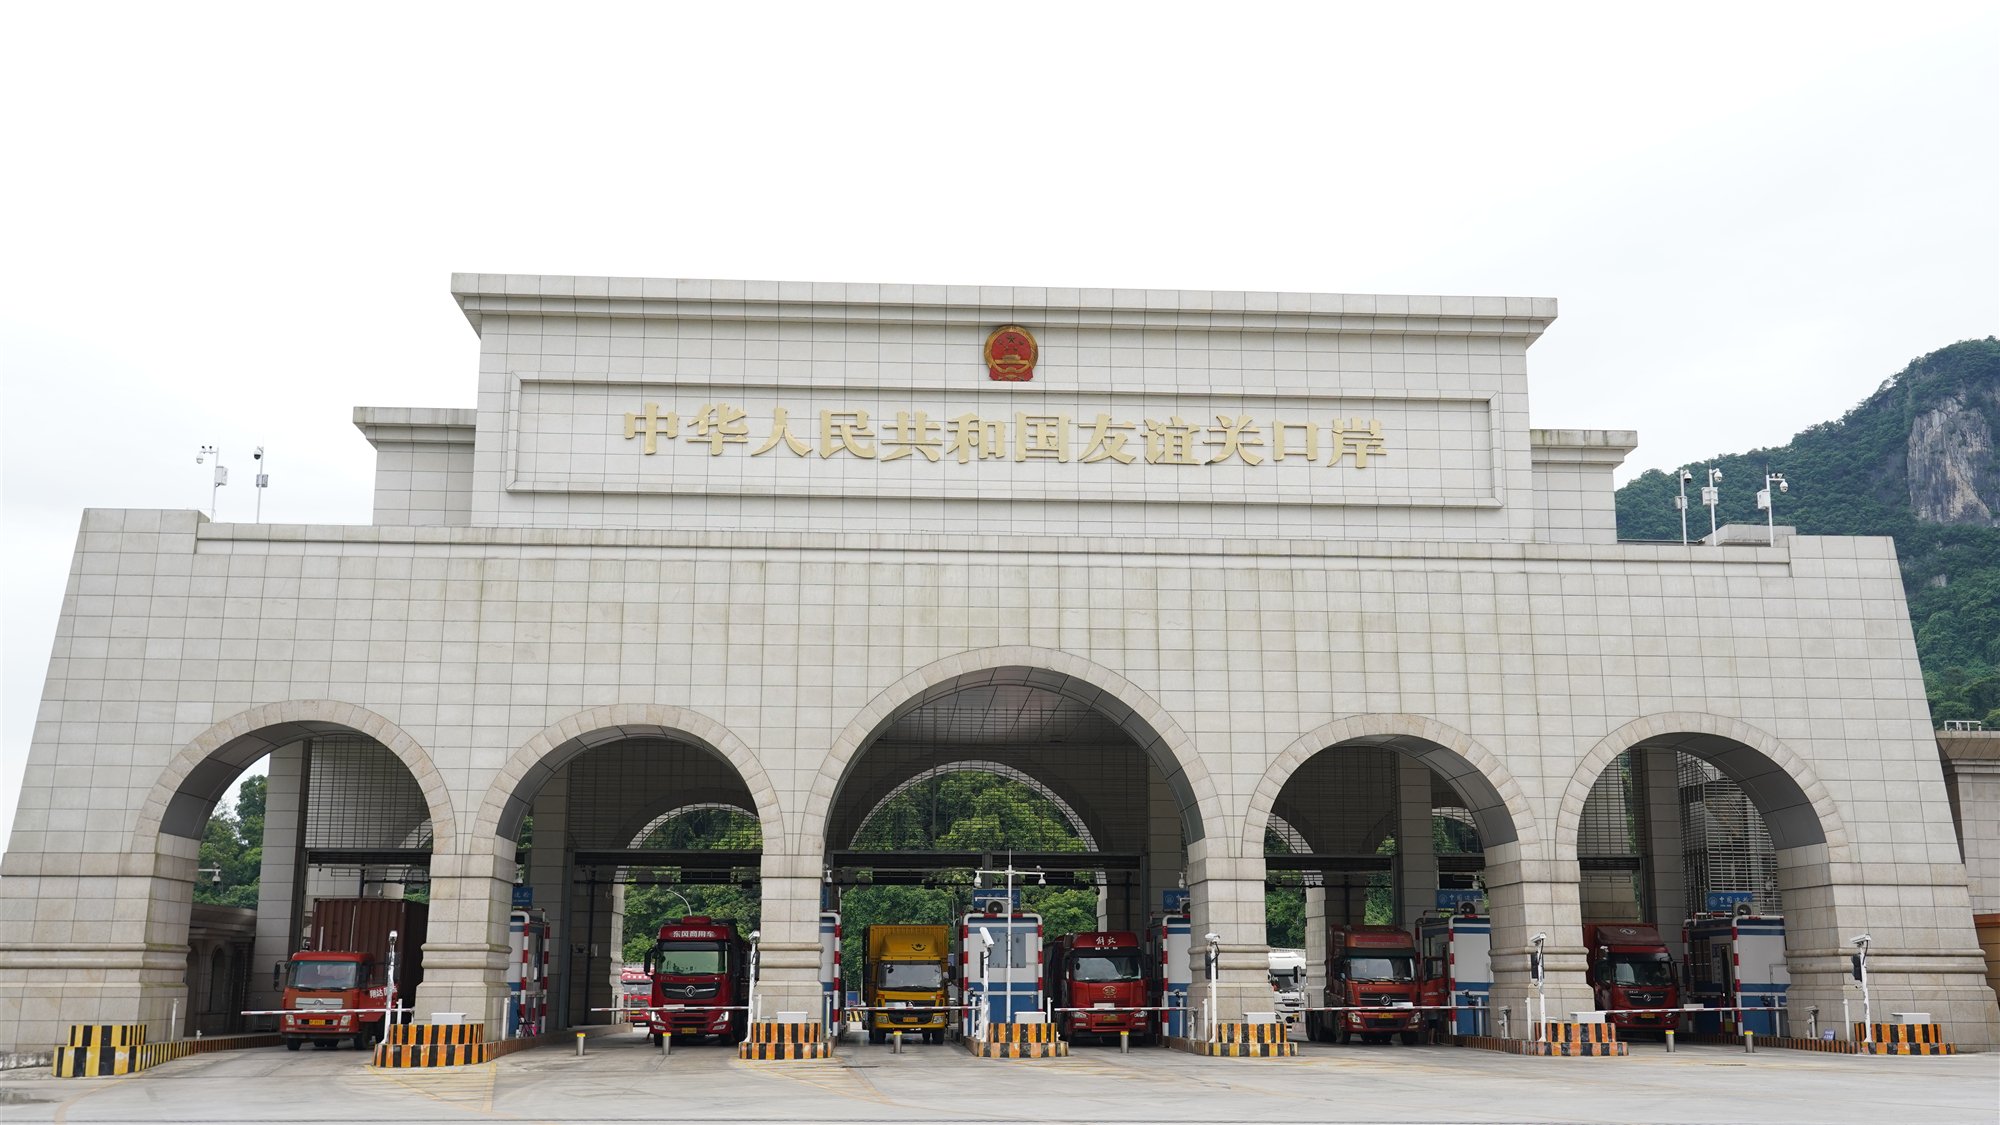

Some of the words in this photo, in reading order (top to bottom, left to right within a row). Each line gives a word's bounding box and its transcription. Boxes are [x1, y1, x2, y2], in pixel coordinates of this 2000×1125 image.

[624, 402, 1387, 469] 中华人民共和国友谊关口岸
[672, 930, 715, 938] 东风商用车
[1096, 936, 1117, 945] 解放
